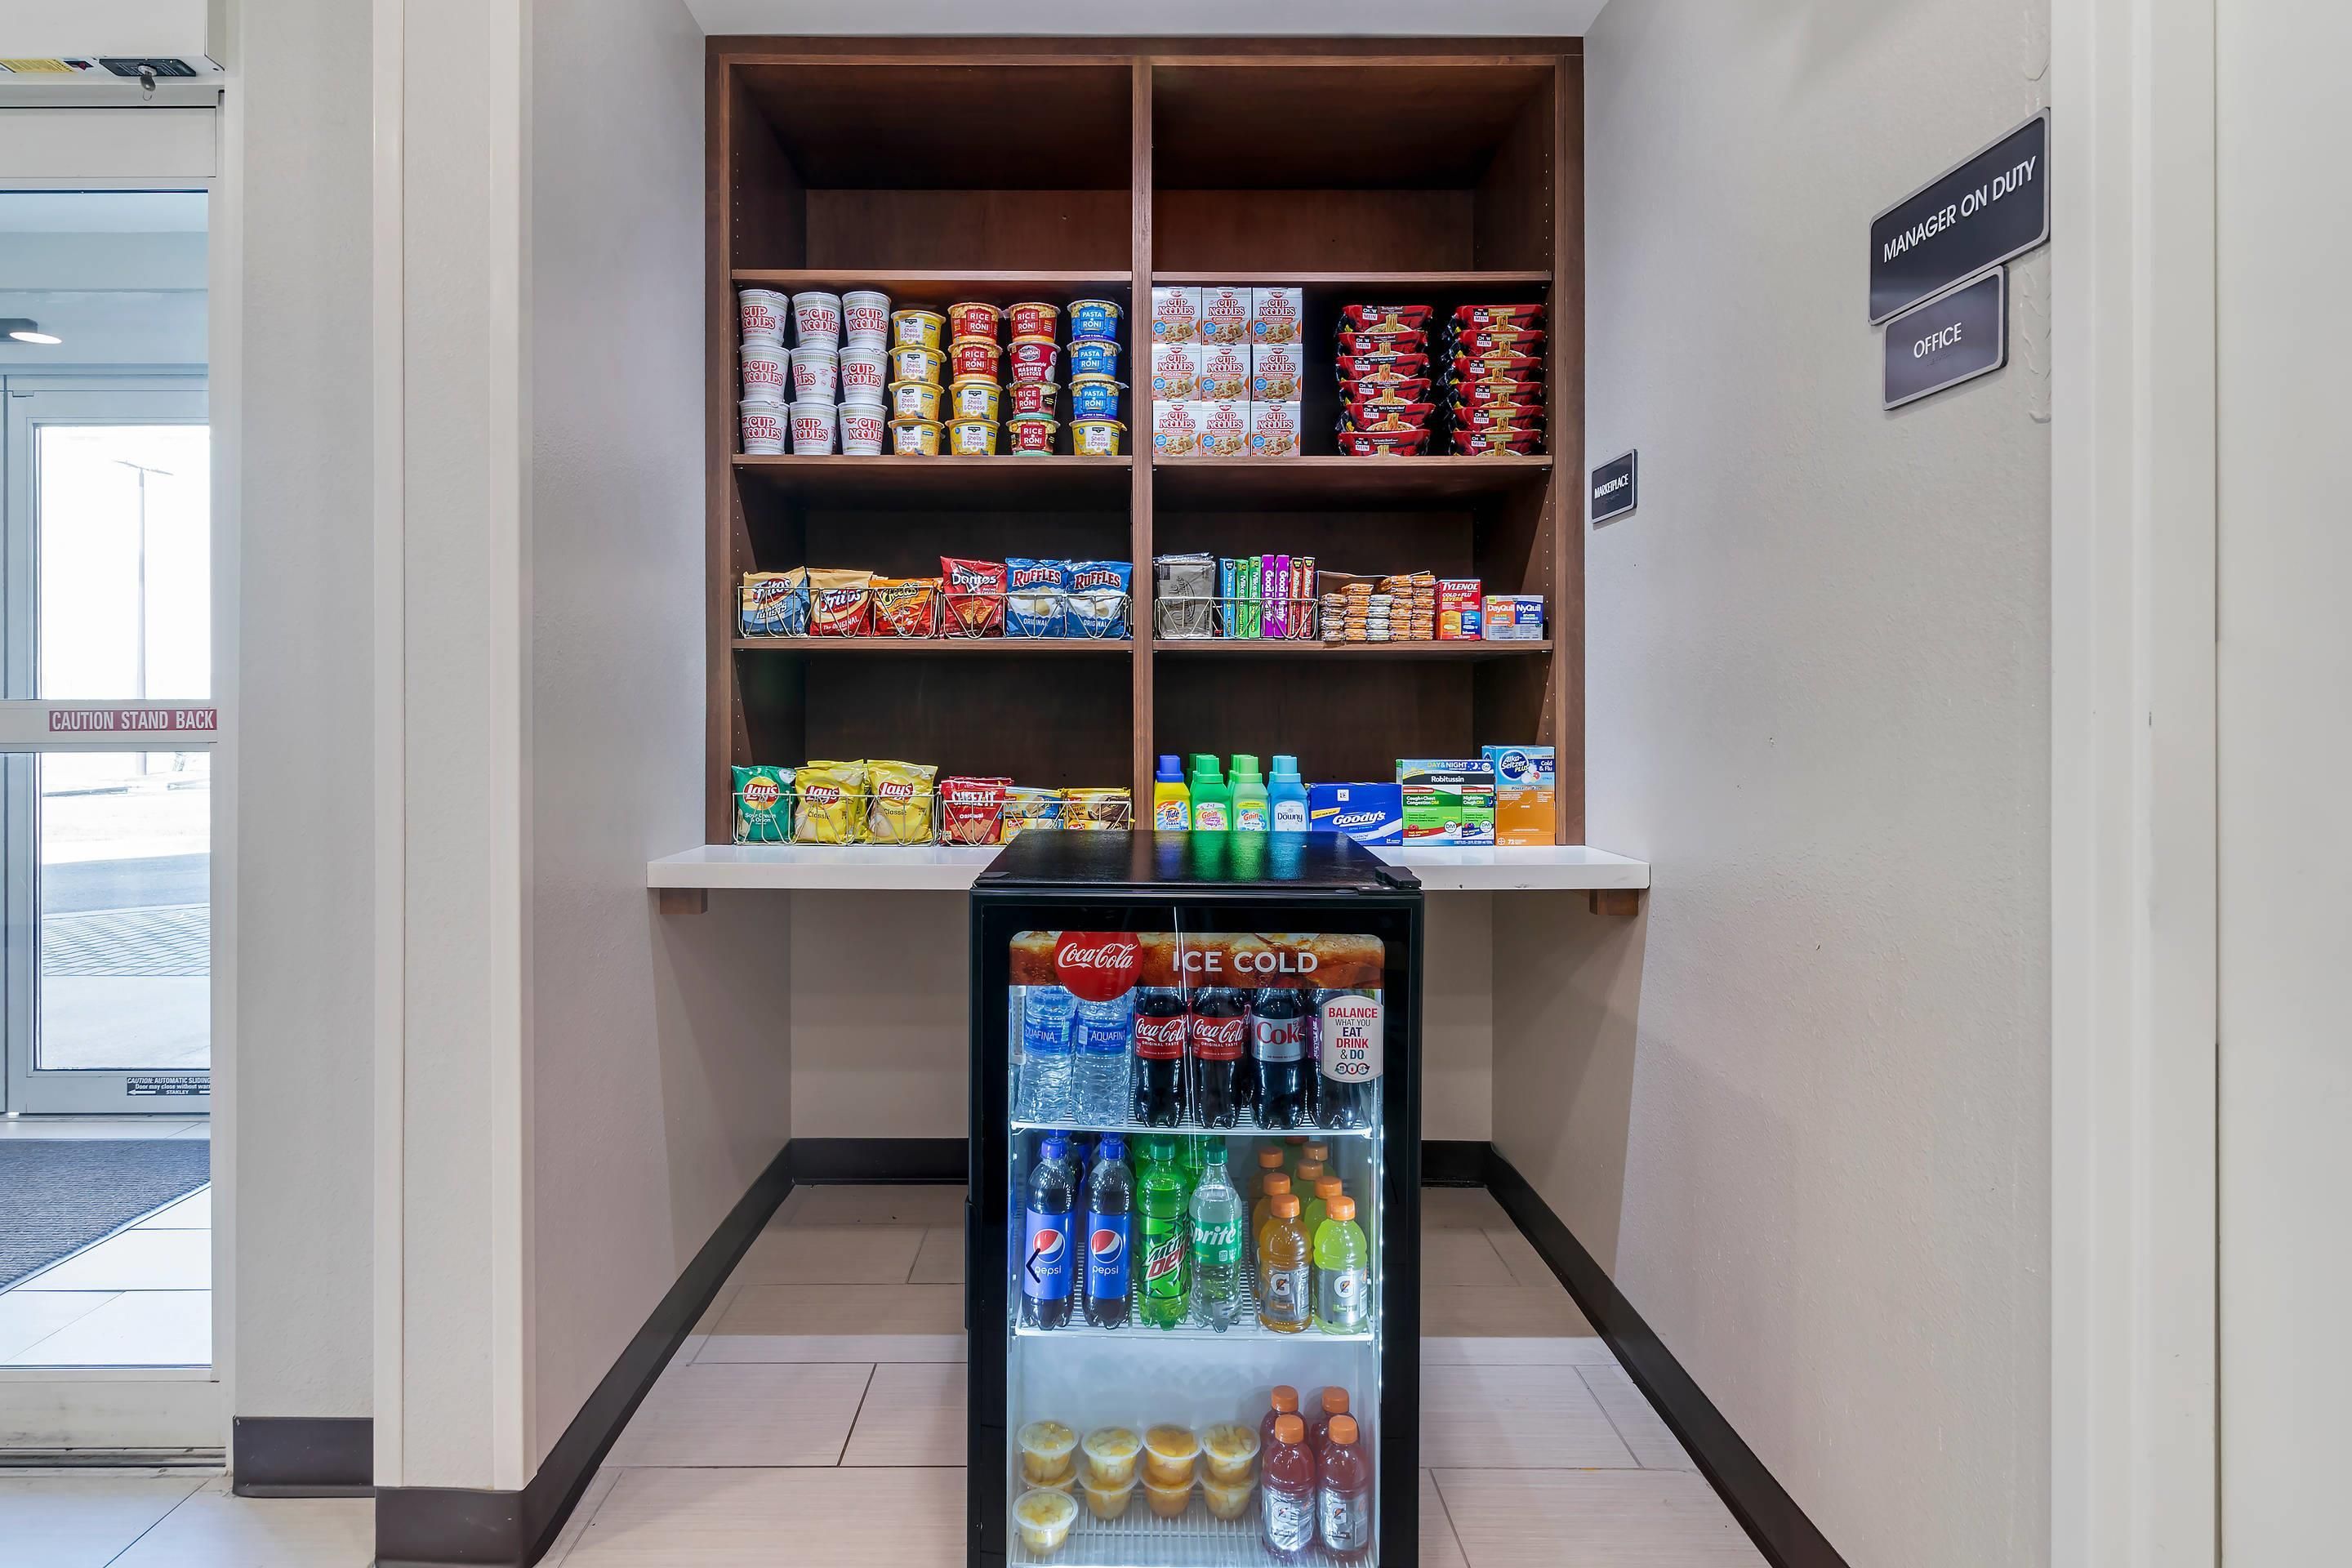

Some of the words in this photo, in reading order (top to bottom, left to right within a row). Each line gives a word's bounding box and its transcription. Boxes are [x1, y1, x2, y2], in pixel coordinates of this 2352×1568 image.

[1884, 205, 1957, 263] MANAGER
[1961, 185, 1986, 217] ON
[1992, 156, 2036, 202] DUTY
[1166, 299, 1187, 307] CUP
[1217, 299, 1237, 308] CUP
[1267, 299, 1288, 308] CUP
[743, 306, 768, 318] CUP
[808, 309, 835, 320] CUP
[856, 308, 883, 318] CUP
[1158, 306, 1195, 315] NOODLES
[1209, 307, 1245, 316] NOODLES
[1259, 307, 1295, 316] NOODLES
[801, 320, 840, 334] NOODLES
[849, 318, 888, 332] NOODLES
[1018, 322, 1036, 330] RONI
[1913, 323, 1962, 359] OFFICE
[1166, 354, 1187, 363] CUP
[1215, 355, 1236, 363] CUP
[1267, 355, 1289, 363] CUP
[750, 361, 777, 372] CUP
[848, 363, 875, 375] CUP
[1158, 363, 1194, 372] NOODLES
[1207, 363, 1243, 372] NOODLES
[1259, 363, 1295, 372] NOODLES
[744, 372, 783, 385] NOODLES
[843, 374, 881, 387] NOODLES
[1168, 412, 1188, 420] CUP
[1215, 412, 1236, 421] CUP
[1266, 412, 1286, 421] CUP
[749, 416, 776, 428] CUP
[795, 418, 821, 430] CUP
[858, 418, 882, 430] CUP
[1159, 419, 1196, 429] NOODLES
[1207, 420, 1243, 430] NOODLES
[1257, 420, 1294, 430] NOODLES
[744, 427, 782, 440] NOODLES
[1595, 474, 1628, 499] MARKETPLACE
[951, 573, 997, 585] Doritos
[1013, 569, 1061, 586] RUFFLES
[1074, 571, 1120, 589] RUFFLES
[1265, 570, 1273, 591] Good
[1279, 570, 1287, 591] Good
[1442, 582, 1478, 590] TYLENOL
[822, 589, 861, 612] Fritos
[1517, 604, 1541, 613] NyQuil
[52, 712, 114, 730] CAUTION
[122, 710, 168, 729] STAND
[176, 710, 213, 729] BACK
[1502, 761, 1526, 769] Seltzer
[746, 784, 778, 800] Lay's
[807, 786, 839, 804] Lay's
[879, 783, 912, 800] Lay's
[1166, 810, 1179, 820] Tide
[1202, 810, 1217, 818] Gain
[1244, 813, 1258, 821] Gain
[1277, 813, 1303, 822] Downy
[1333, 811, 1386, 825] Goody's
[1058, 942, 1138, 969] Coca-Cola
[1173, 951, 1222, 972] ICE
[1234, 951, 1319, 973] COLD
[1329, 1008, 1378, 1018] BALANCE
[1136, 1018, 1186, 1043] Coca-Cola
[1193, 1018, 1244, 1043] Coca-Cola
[1336, 1038, 1369, 1048] DRINK
[1340, 1049, 1348, 1059] &
[1350, 1049, 1364, 1059] DO
[1035, 1266, 1061, 1276] pepsi
[1093, 1266, 1118, 1276] pepsi
